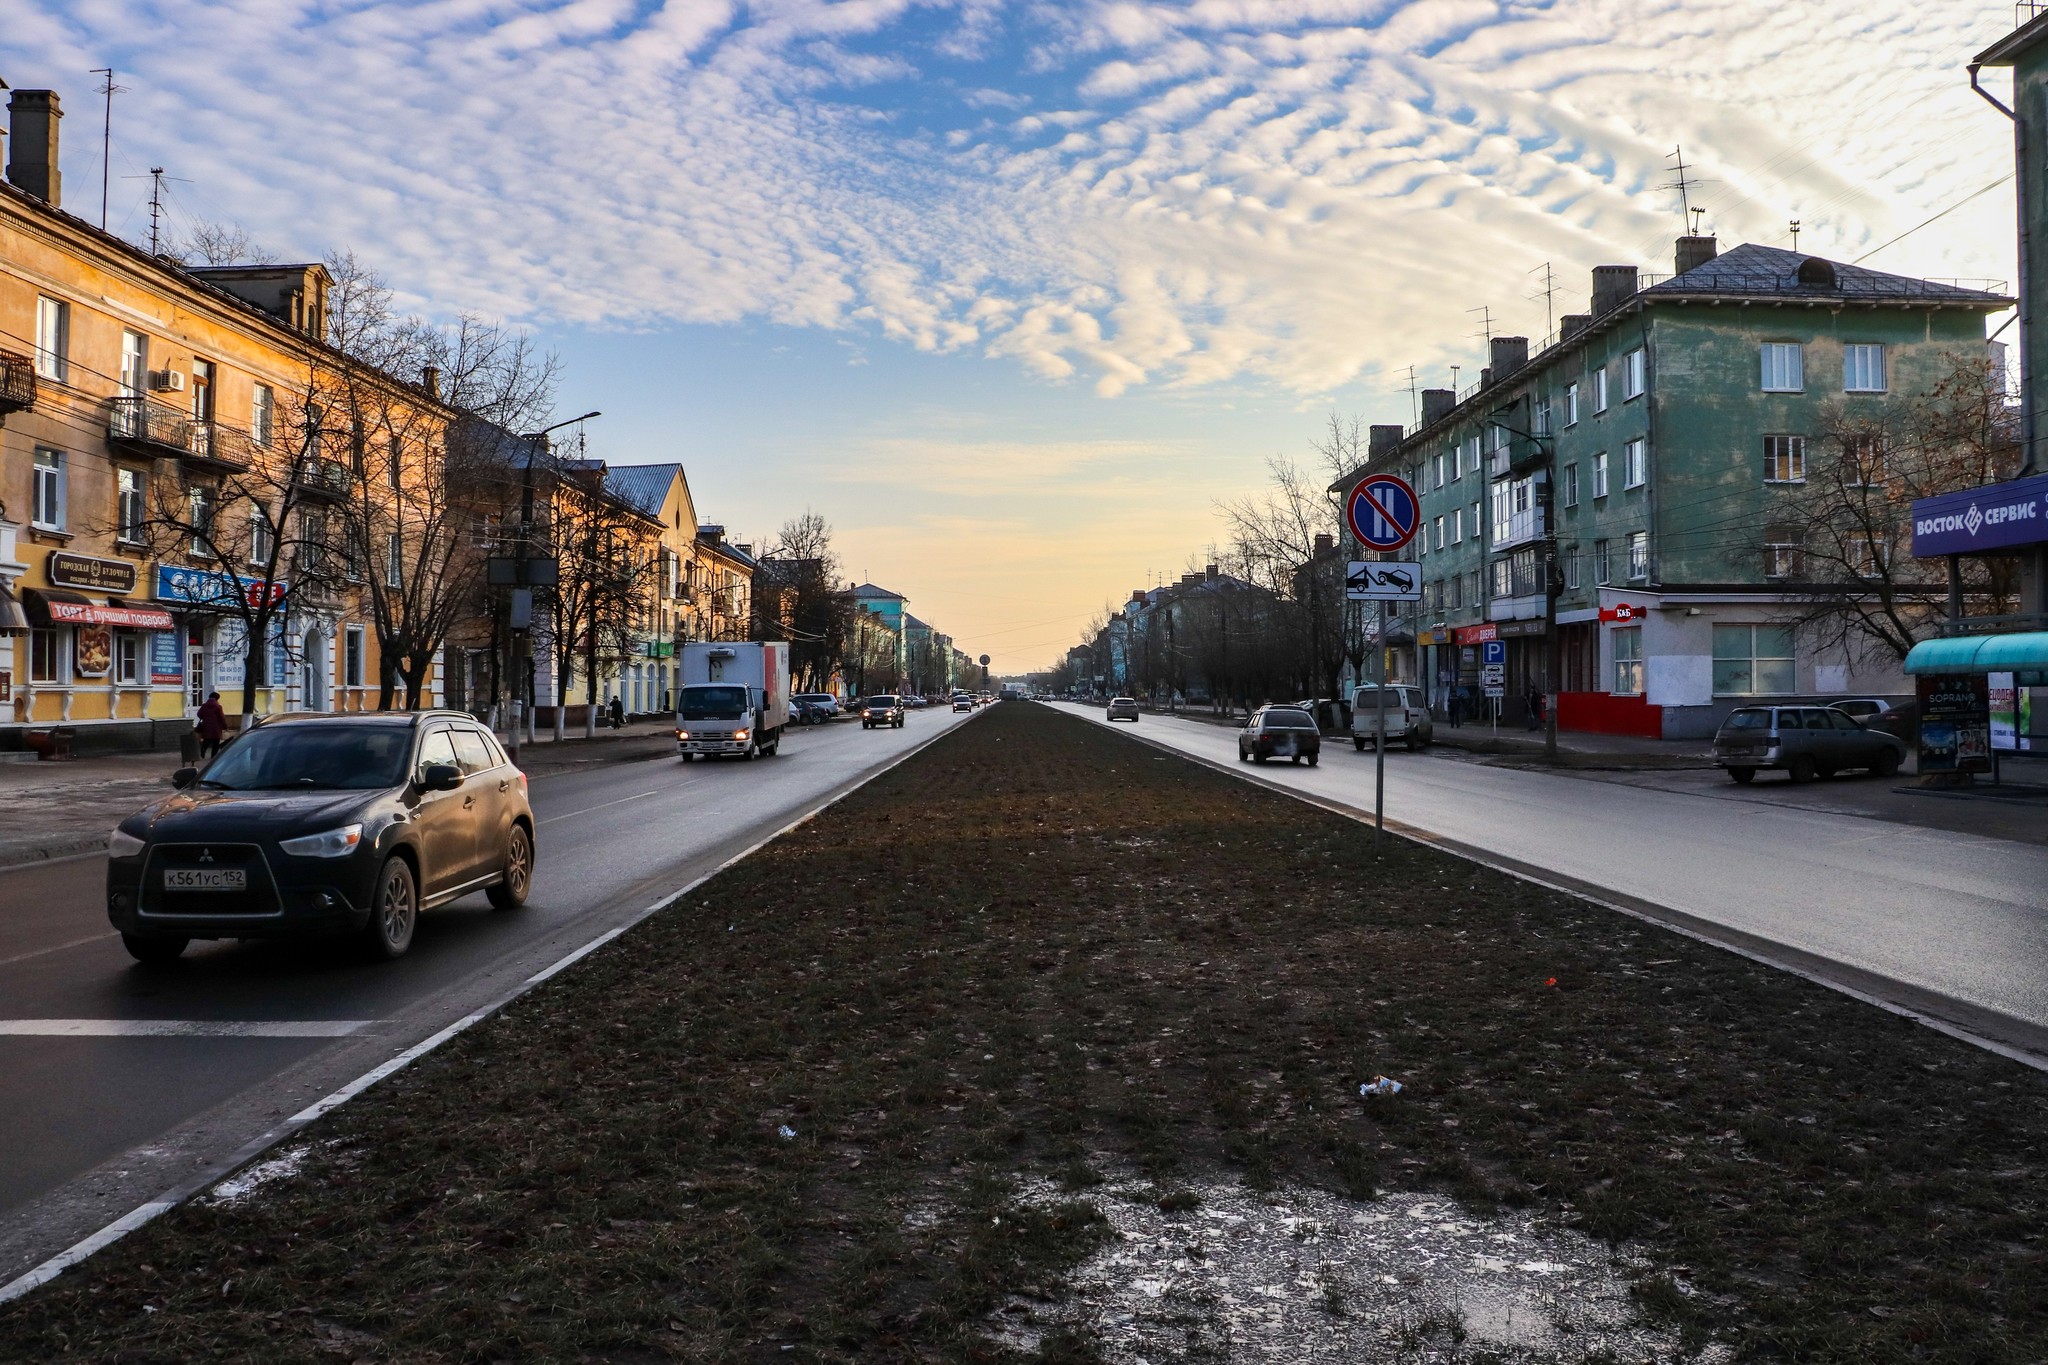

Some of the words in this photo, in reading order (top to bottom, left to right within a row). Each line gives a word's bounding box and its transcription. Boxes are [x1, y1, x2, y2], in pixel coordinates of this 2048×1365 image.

[1916, 514, 1964, 536] ВОСТОК
[1984, 502, 2036, 524] СЕРВИС
[60, 561, 90, 573] ГОРОДСКАЯ
[102, 567, 130, 578] БУЛОЧНАЯ
[54, 604, 82, 619] ТОРТ
[94, 610, 130, 624] лучший
[1480, 626, 1496, 641] ДВЕРЕЙ
[1488, 644, 1500, 660] P
[168, 872, 220, 886] К561УС
[222, 872, 242, 882] 152
